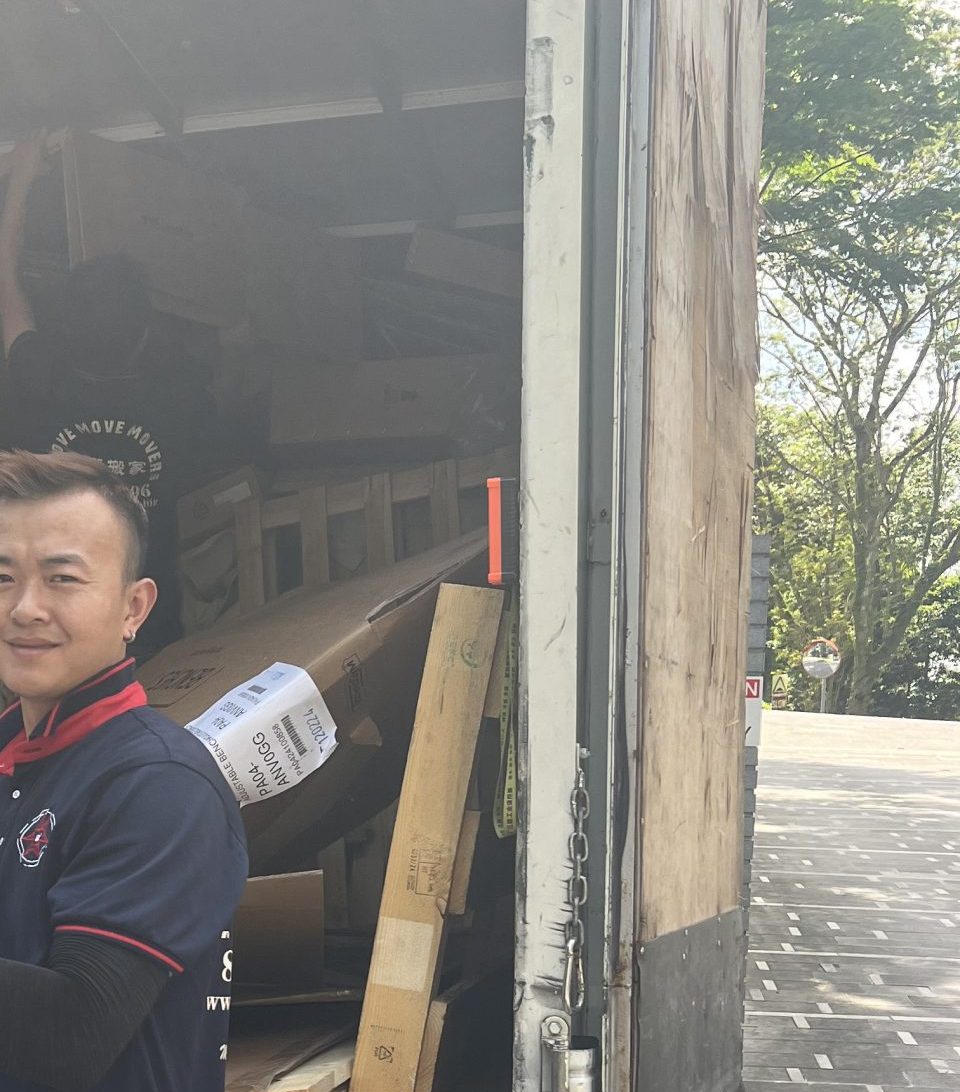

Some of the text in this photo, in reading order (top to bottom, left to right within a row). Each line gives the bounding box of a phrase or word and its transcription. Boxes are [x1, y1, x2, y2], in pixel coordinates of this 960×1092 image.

[51, 420, 161, 481] OVE MOVE MOVERS
[745, 681, 758, 697] N
[248, 762, 272, 796] PA04-
[221, 949, 233, 981] 8
